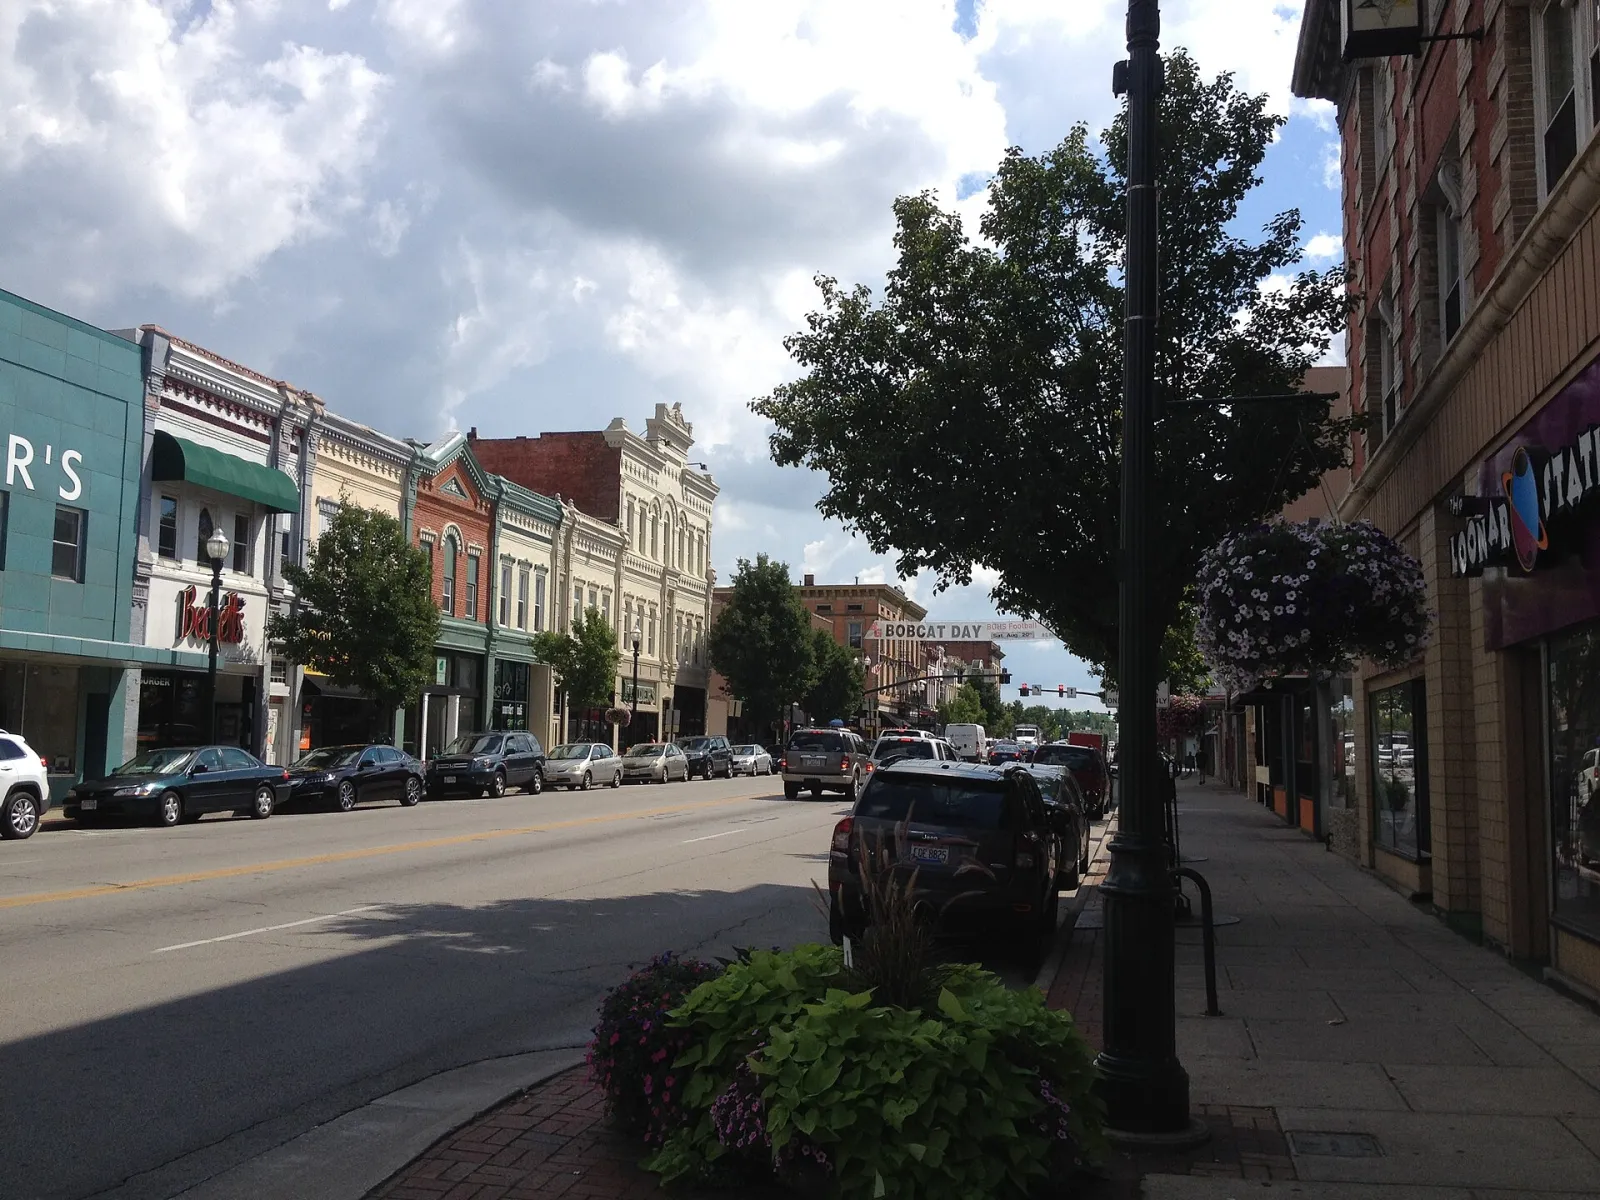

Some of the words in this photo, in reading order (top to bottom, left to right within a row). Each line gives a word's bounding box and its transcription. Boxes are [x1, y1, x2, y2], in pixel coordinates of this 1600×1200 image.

[1450, 501, 1511, 574] LOONAR
[885, 624, 946, 639] BOBCAT
[951, 624, 983, 639] DAY
[1008, 622, 1037, 631] Football
